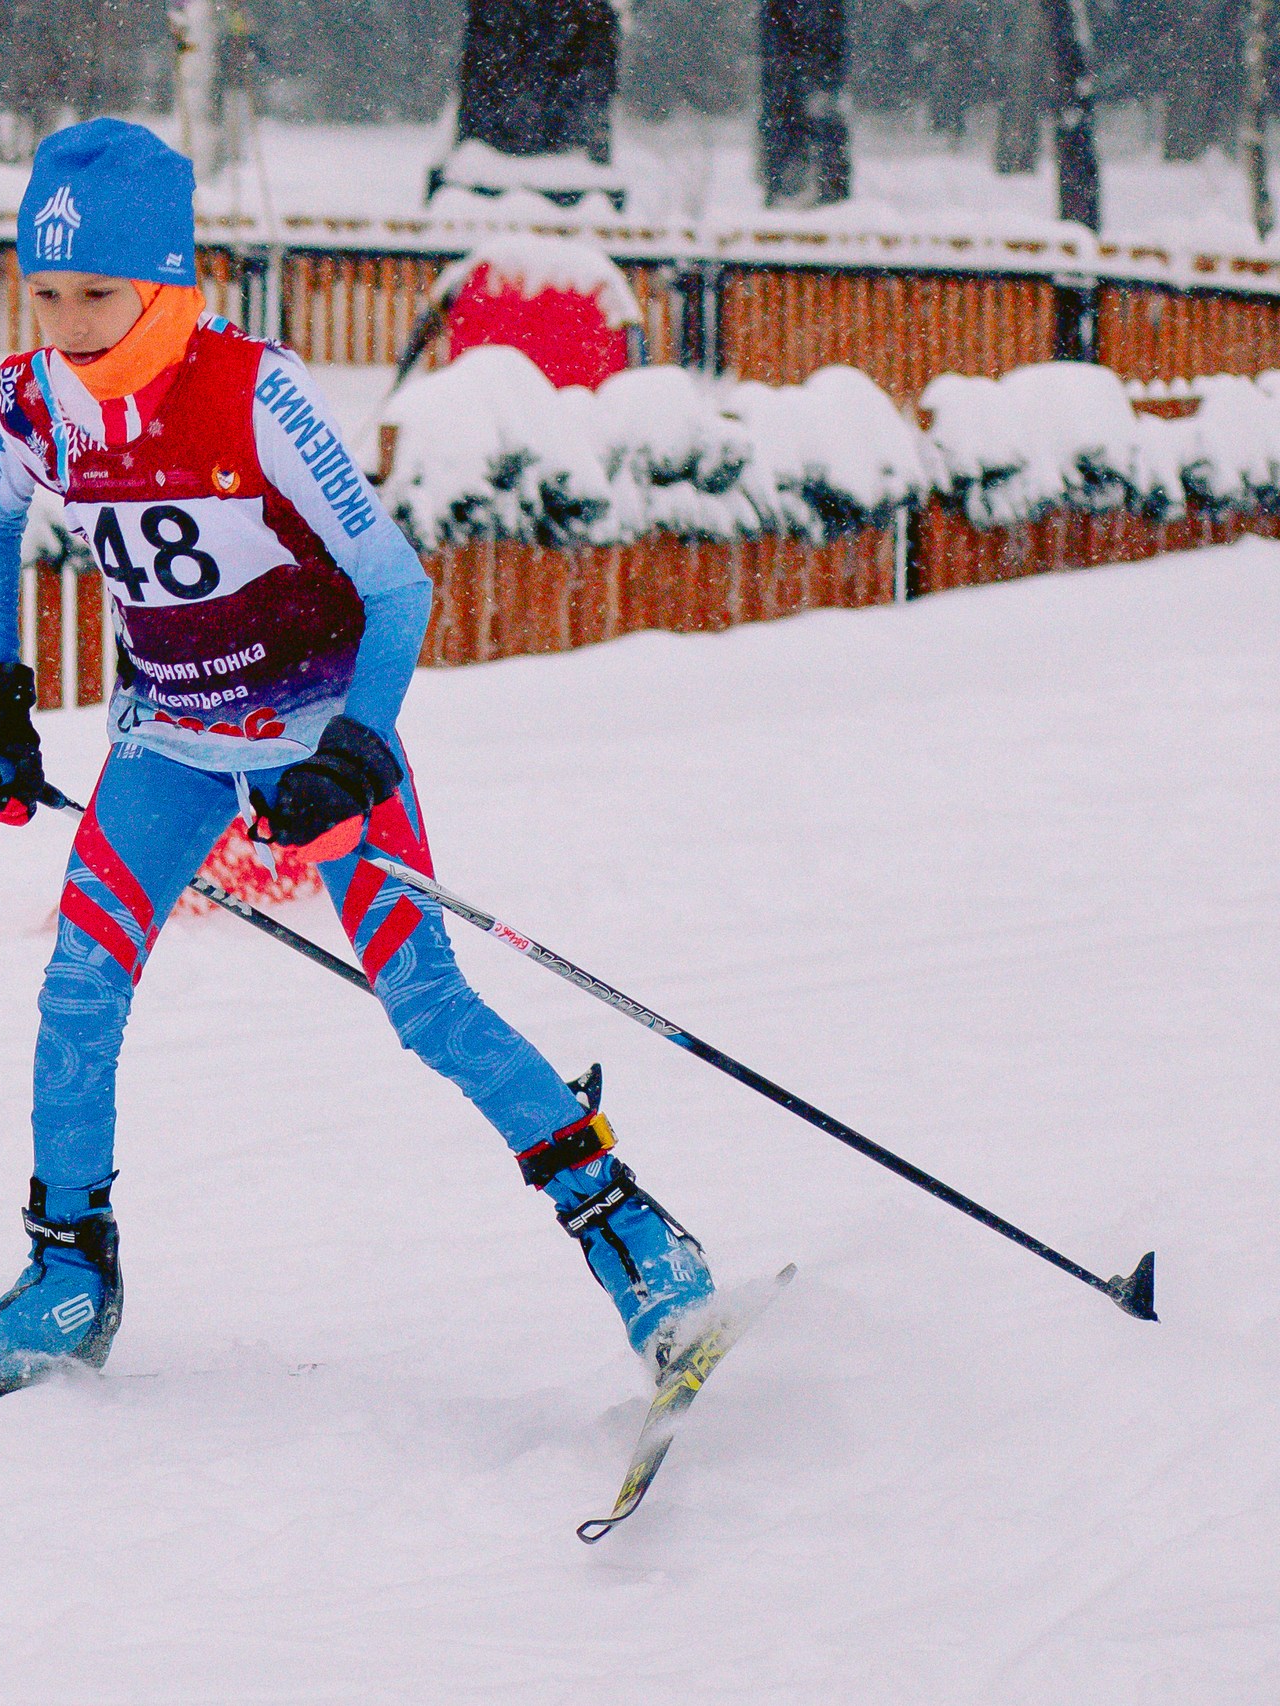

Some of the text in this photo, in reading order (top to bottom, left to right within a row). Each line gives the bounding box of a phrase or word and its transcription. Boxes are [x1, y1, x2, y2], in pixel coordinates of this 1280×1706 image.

[83, 470, 109, 480] ПАРКИ
[255, 367, 377, 539] АКАДЕМИЯ
[93, 504, 221, 602] 48
[202, 642, 267, 678] гонка
[529, 945, 682, 1037] NORDWAY
[24, 1218, 76, 1243] SPINE
[568, 1187, 625, 1232] SPINE
